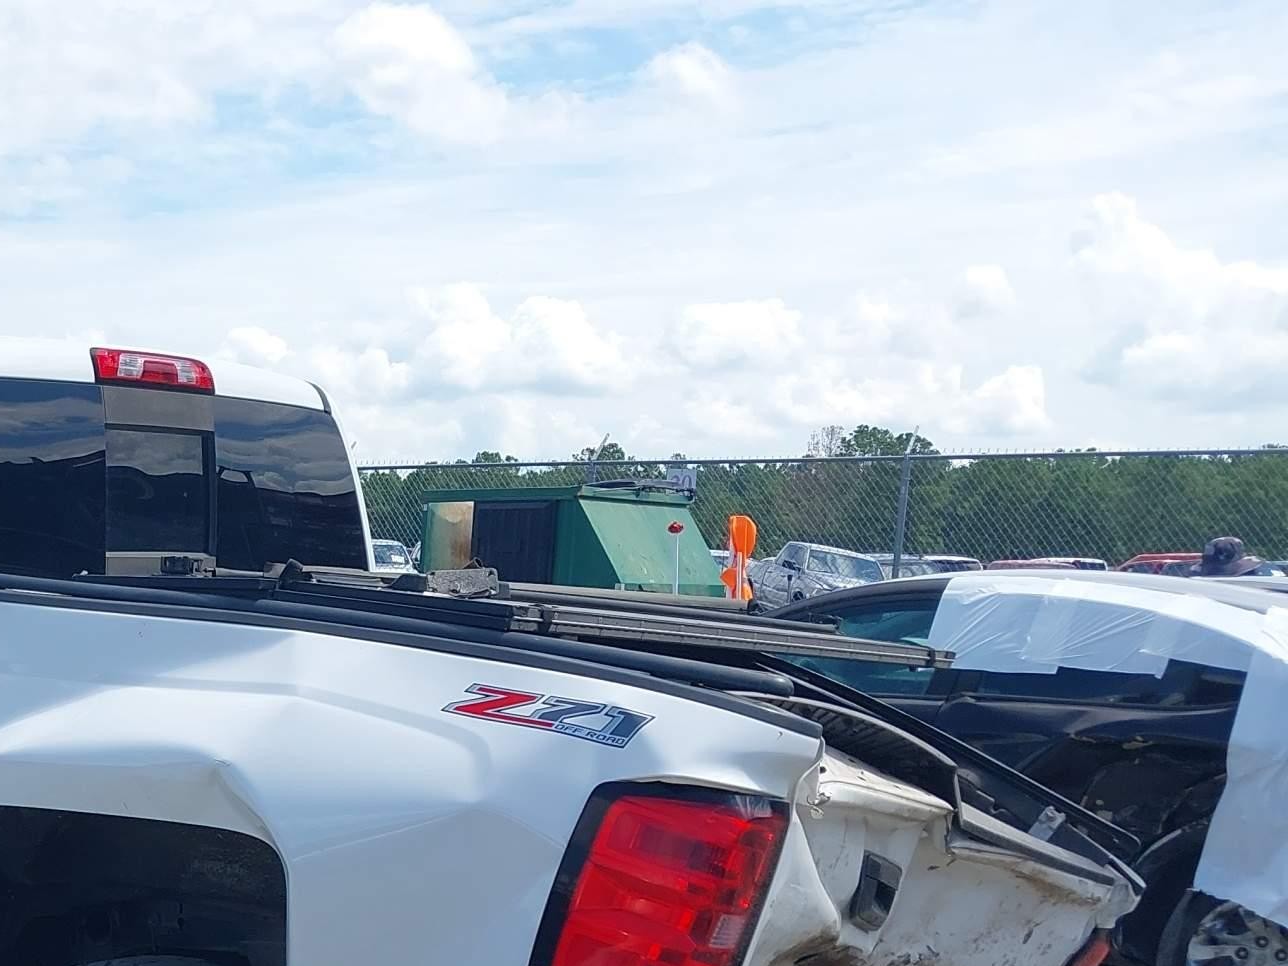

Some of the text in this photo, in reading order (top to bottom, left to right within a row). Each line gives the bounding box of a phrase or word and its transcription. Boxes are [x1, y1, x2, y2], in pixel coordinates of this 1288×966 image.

[441, 683, 656, 738] Z71
[554, 723, 627, 745] OFF ROAD
